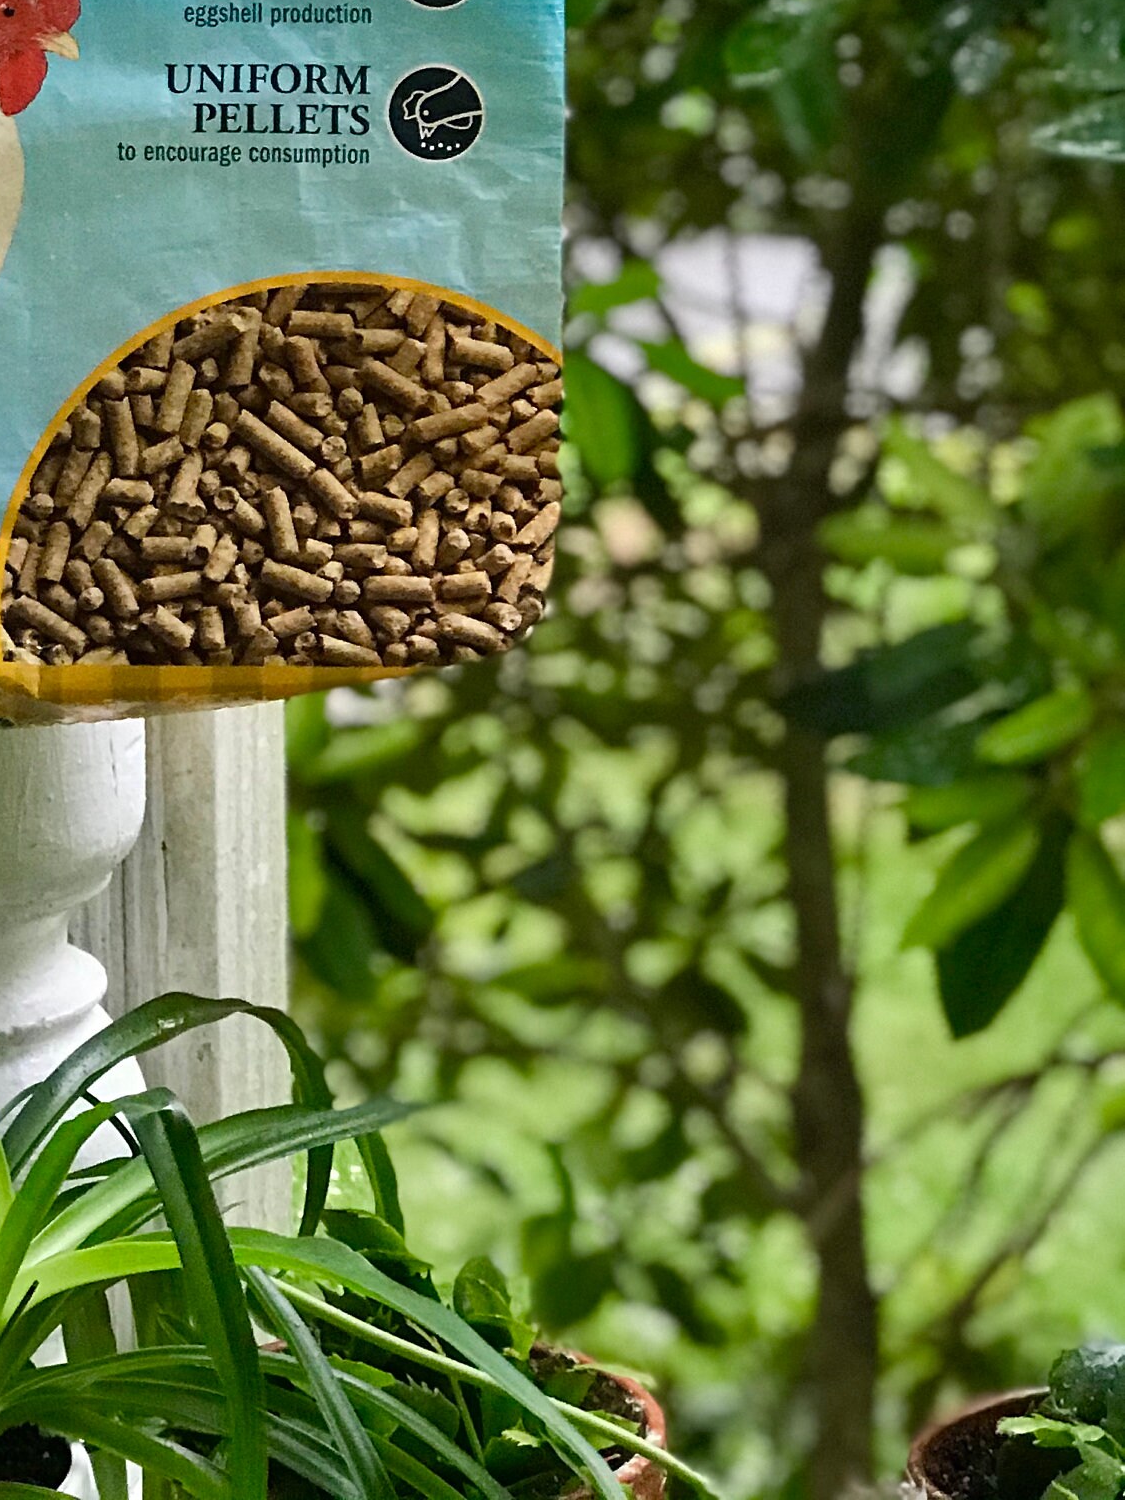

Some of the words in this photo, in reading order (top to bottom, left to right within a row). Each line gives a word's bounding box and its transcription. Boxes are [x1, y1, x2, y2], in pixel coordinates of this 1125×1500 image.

[183, 2, 263, 27] eggshell
[270, 3, 372, 27] production
[164, 63, 372, 95] UNIFORM
[191, 102, 371, 136] PELLETS
[116, 141, 136, 162] to
[143, 144, 242, 167] encourage
[248, 143, 371, 168] consumption
